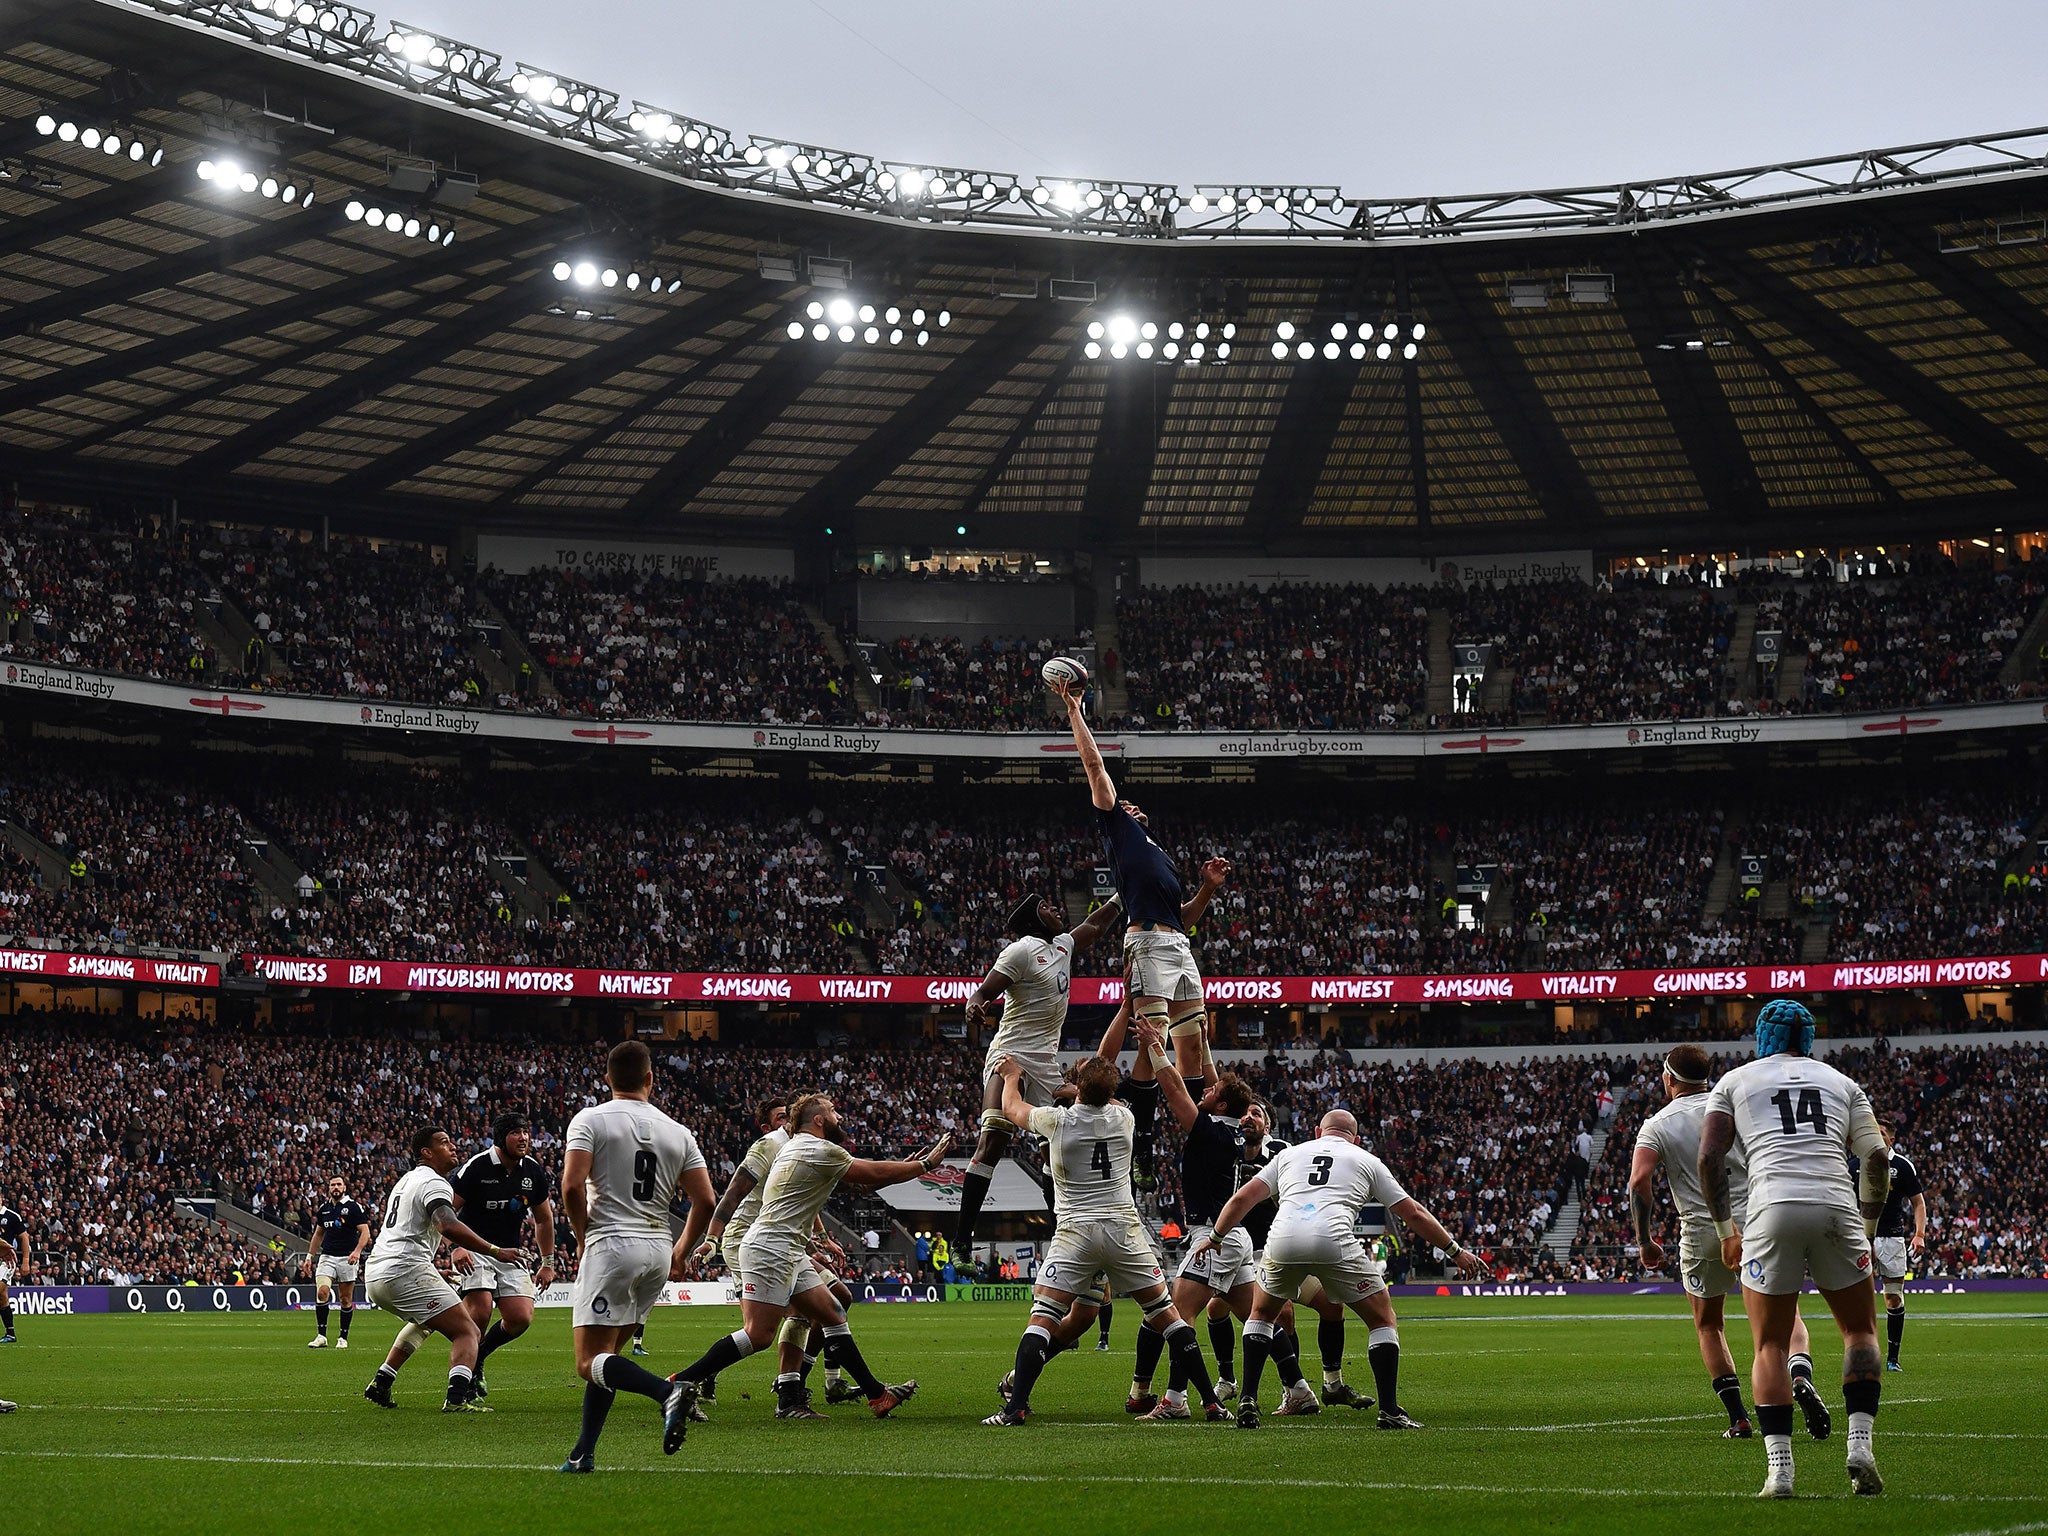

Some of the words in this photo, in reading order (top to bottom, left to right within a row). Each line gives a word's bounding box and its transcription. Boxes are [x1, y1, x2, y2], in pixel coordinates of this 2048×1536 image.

[556, 550, 577, 565] TO
[583, 552, 636, 568] CARRY
[642, 554, 666, 568] ME
[672, 555, 719, 571] HOME
[1464, 563, 1527, 580] England
[1531, 562, 1581, 578] Rugby
[19, 667, 73, 690] England
[75, 676, 115, 698] Rugby
[375, 708, 432, 727] England
[435, 713, 480, 733] Rugby
[769, 732, 830, 749] England
[833, 734, 880, 752] Rugby
[1643, 726, 1707, 744] England
[1710, 724, 1760, 742] Rugby
[1219, 738, 1363, 756] englandrugby.com
[0, 951, 46, 972] TWEST
[67, 956, 135, 979] SAMSUNG
[154, 963, 207, 983] VITALITY
[349, 965, 381, 985] IBM
[407, 967, 501, 988] MITSUBISHI
[505, 971, 574, 992] MOTORS
[599, 974, 672, 995] NATWEST
[702, 977, 791, 998] SAMSUNG
[819, 979, 892, 998] VITALITY
[927, 980, 984, 1000] GUINN
[1205, 981, 1283, 999] MOTORS
[1311, 980, 1394, 998] NATWEST
[1422, 978, 1514, 998] SAMSUNG
[1541, 976, 1617, 995] VITALITY
[1653, 972, 1747, 992] GUINNESS
[1770, 970, 1805, 989] IBM
[1833, 964, 1931, 987] MITSUBISHI
[1936, 960, 2012, 983] MOTORS
[1771, 1090, 1828, 1135] 14
[1091, 1142, 1112, 1180] 4
[1308, 1156, 1333, 1185] 3
[633, 1150, 657, 1201] 9
[386, 1196, 401, 1229] 8
[486, 1200, 509, 1210] BT
[324, 1220, 334, 1228] BT
[1045, 1265, 1058, 1282] O2
[1689, 1274, 1705, 1293] O2
[1749, 1259, 1766, 1285] O2
[9, 1291, 74, 1314] atWest
[127, 1288, 146, 1313] O2
[166, 1288, 185, 1312] O2
[212, 1288, 231, 1312] O2
[250, 1288, 268, 1312] O2
[554, 1291, 569, 1301] 2017
[972, 1286, 1028, 1301] GILBERT
[592, 1297, 611, 1319] O2
